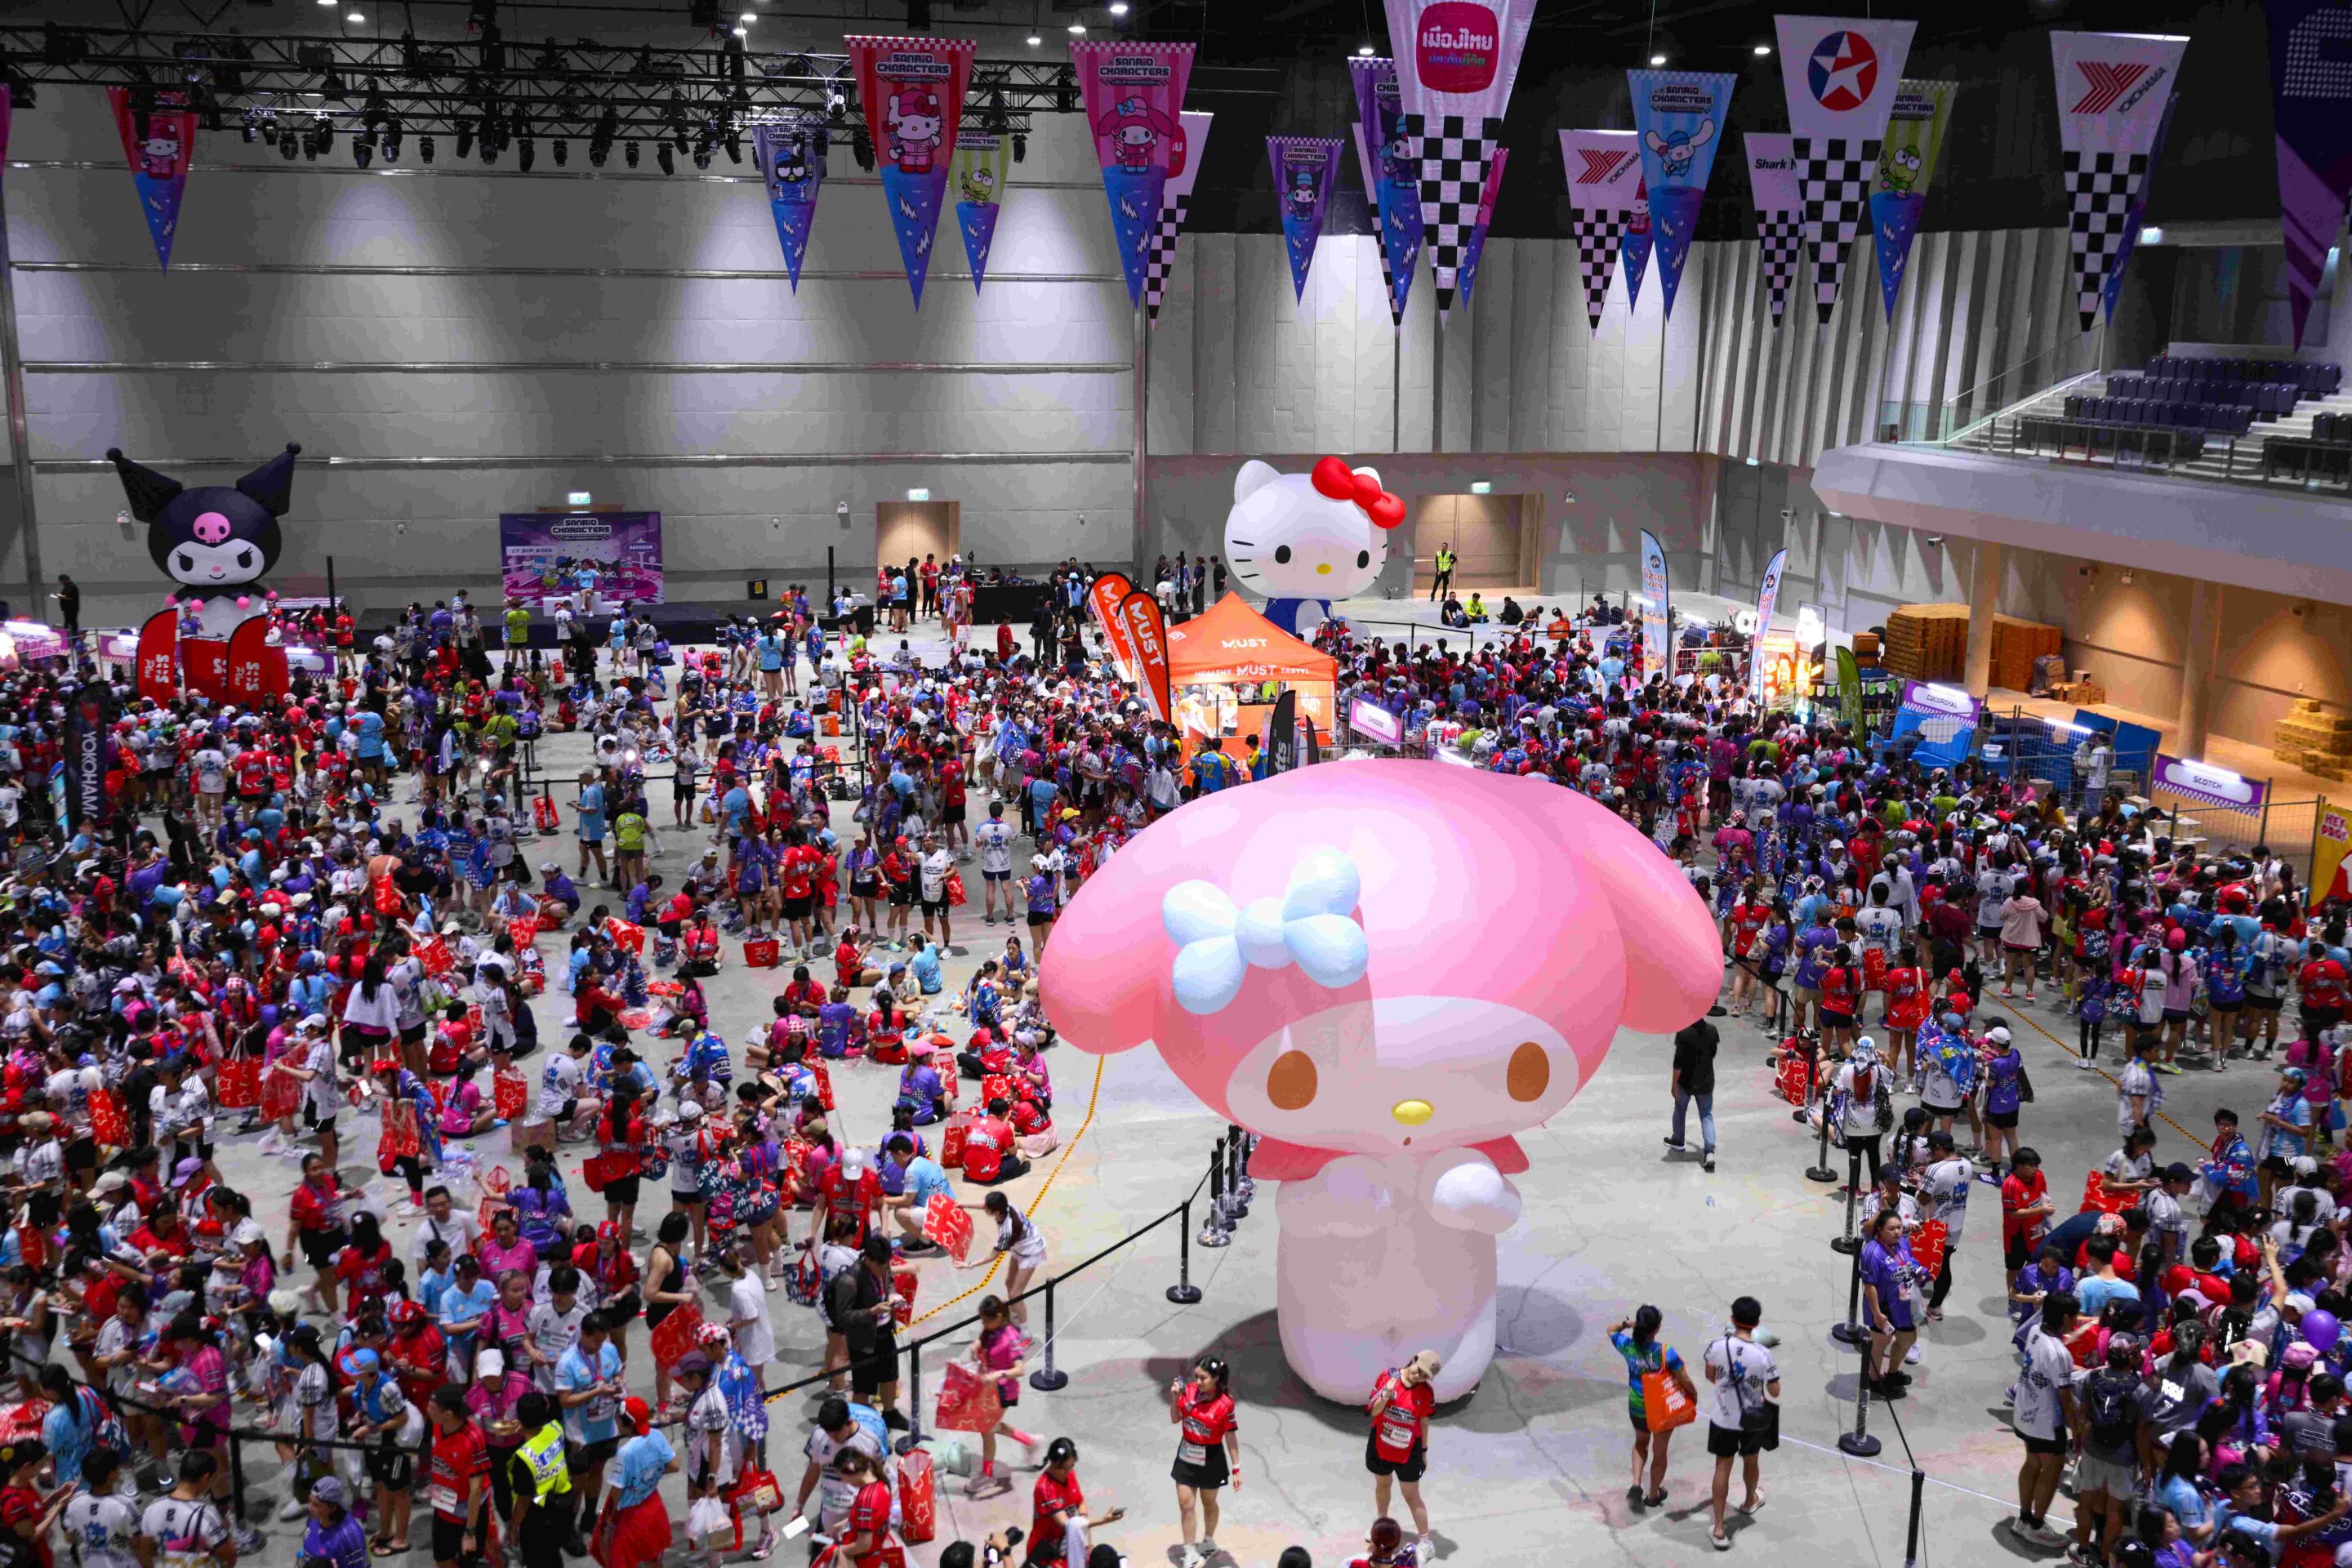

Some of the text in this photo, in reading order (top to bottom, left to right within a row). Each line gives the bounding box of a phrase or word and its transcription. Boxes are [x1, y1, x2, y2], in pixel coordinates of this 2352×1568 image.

[1423, 24, 1494, 51] เมืองไทย
[876, 64, 950, 74] CHARACTERS
[1099, 67, 1169, 76] CHARACTERS
[2117, 66, 2167, 114] YOKOHAMA
[1651, 95, 1713, 105] CHARACTERS
[1895, 95, 1922, 103] ANRIO
[1755, 158, 1787, 170] Shark
[1130, 601, 1165, 666] MUST
[1221, 639, 1267, 648] MUST
[1195, 668, 1232, 678] HEALTHY
[1236, 664, 1277, 676] MUST
[1927, 694, 1958, 709] COCOROYAL
[1203, 764, 1215, 778] 12
[2194, 775, 2222, 790] SCOTCH
[2325, 813, 2345, 829] HEY
[1958, 1165, 1964, 1175] B
[2189, 1277, 2200, 1289] H
